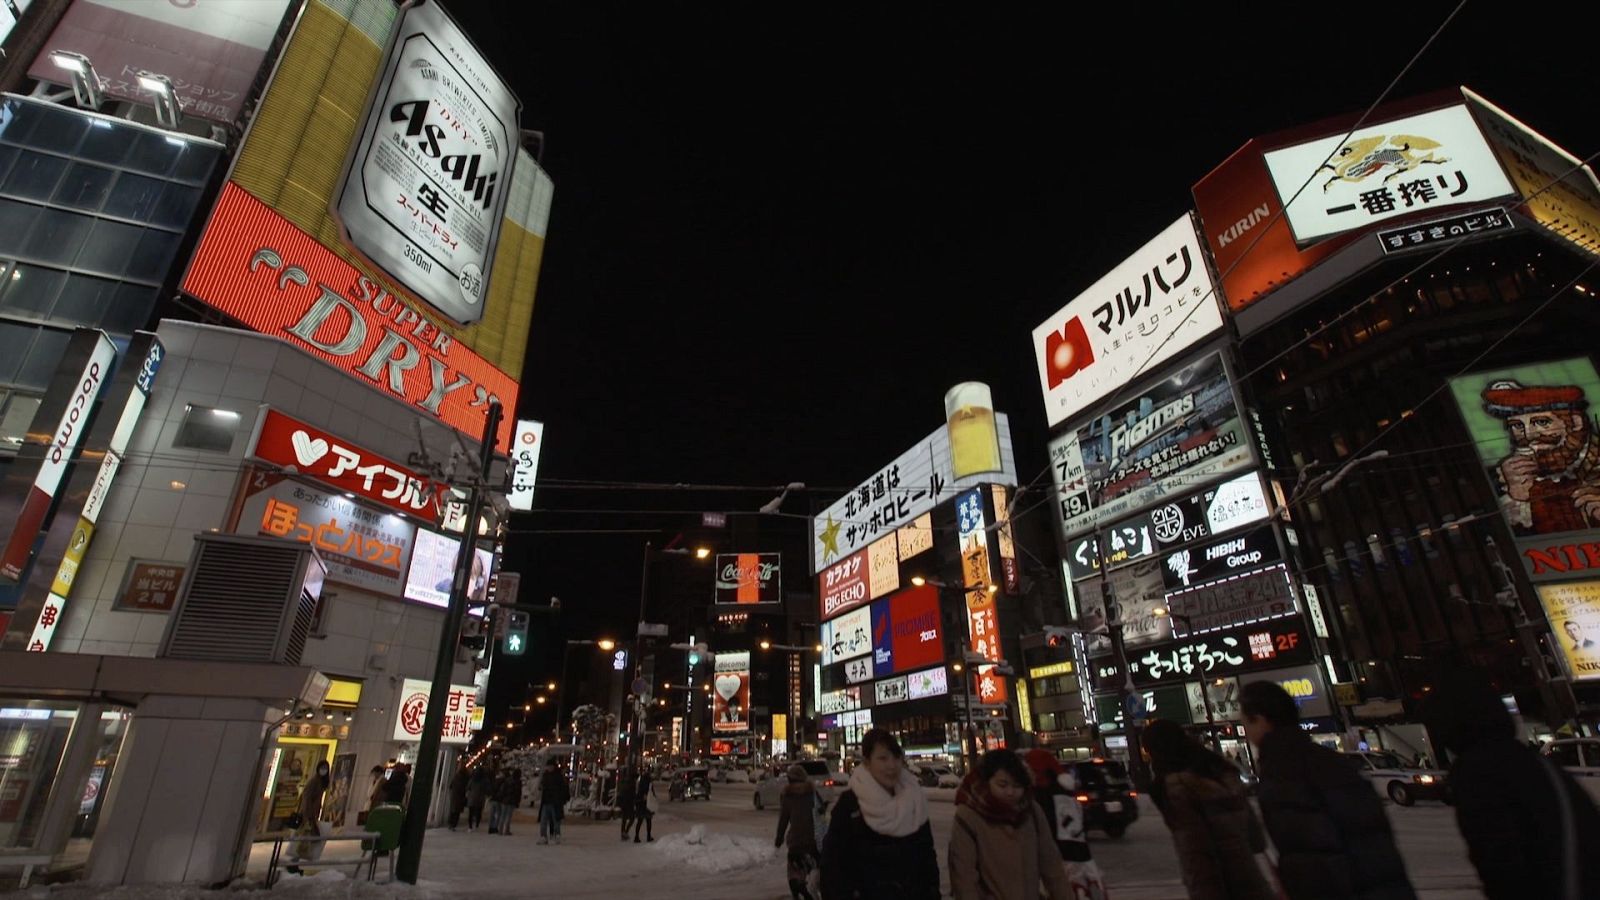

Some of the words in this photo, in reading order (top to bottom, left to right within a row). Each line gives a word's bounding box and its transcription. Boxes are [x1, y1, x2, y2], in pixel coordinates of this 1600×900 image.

[121, 64, 239, 102] ドショップ
[420, 68, 439, 82] ASAHI
[442, 74, 477, 116] BREWERIES
[476, 118, 493, 150] LIMITED
[390, 100, 497, 210] Asahi
[417, 182, 449, 223] 生
[1325, 170, 1469, 216] 一番搾り
[397, 193, 459, 251] スーパードライ
[1218, 202, 1271, 248] KIRIN
[1388, 215, 1502, 248] すすきのビル
[403, 243, 433, 275] 350ml
[1092, 245, 1192, 335] マルハン
[351, 274, 454, 357] SUPER
[1101, 286, 1202, 359] 人生にヨロコビを
[51, 362, 99, 465] docomo
[1108, 392, 1196, 471] FIGHTERS
[328, 444, 428, 510] アイフル
[1093, 444, 1181, 490] ファイターズを見ずに
[844, 463, 901, 519] 北海道は
[846, 472, 945, 548] サッポロビール
[262, 496, 403, 570] ほっとハウス
[1183, 523, 1208, 542] EVE
[1206, 538, 1246, 560] HIBIKI
[826, 556, 861, 588] カラオケ
[1226, 550, 1262, 568] Group
[824, 594, 841, 615] BIG
[841, 582, 865, 602] ECHO
[718, 661, 746, 669] docomo
[1141, 636, 1244, 680] さっぽろっこ
[1276, 633, 1298, 651] 2F
